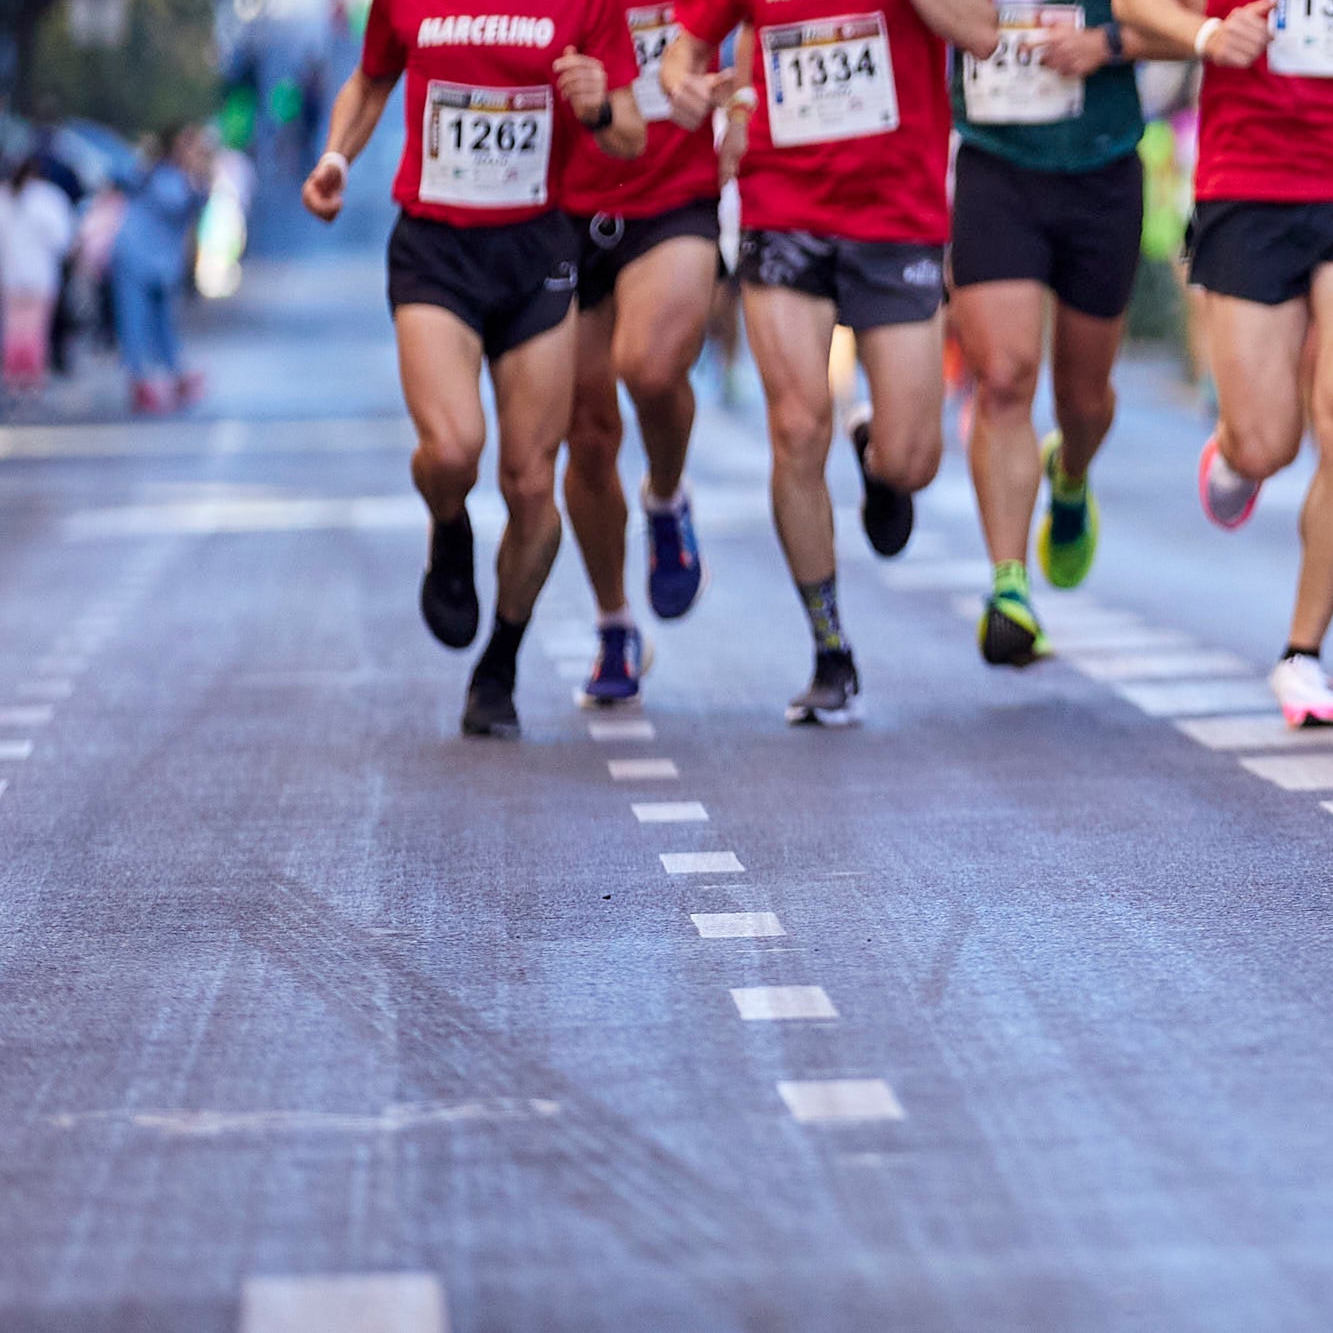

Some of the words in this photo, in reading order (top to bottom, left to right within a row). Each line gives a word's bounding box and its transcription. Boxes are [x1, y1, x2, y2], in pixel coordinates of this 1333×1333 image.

[417, 14, 555, 48] MARCELINO
[790, 44, 876, 88] 1334
[450, 117, 539, 153] 1262
